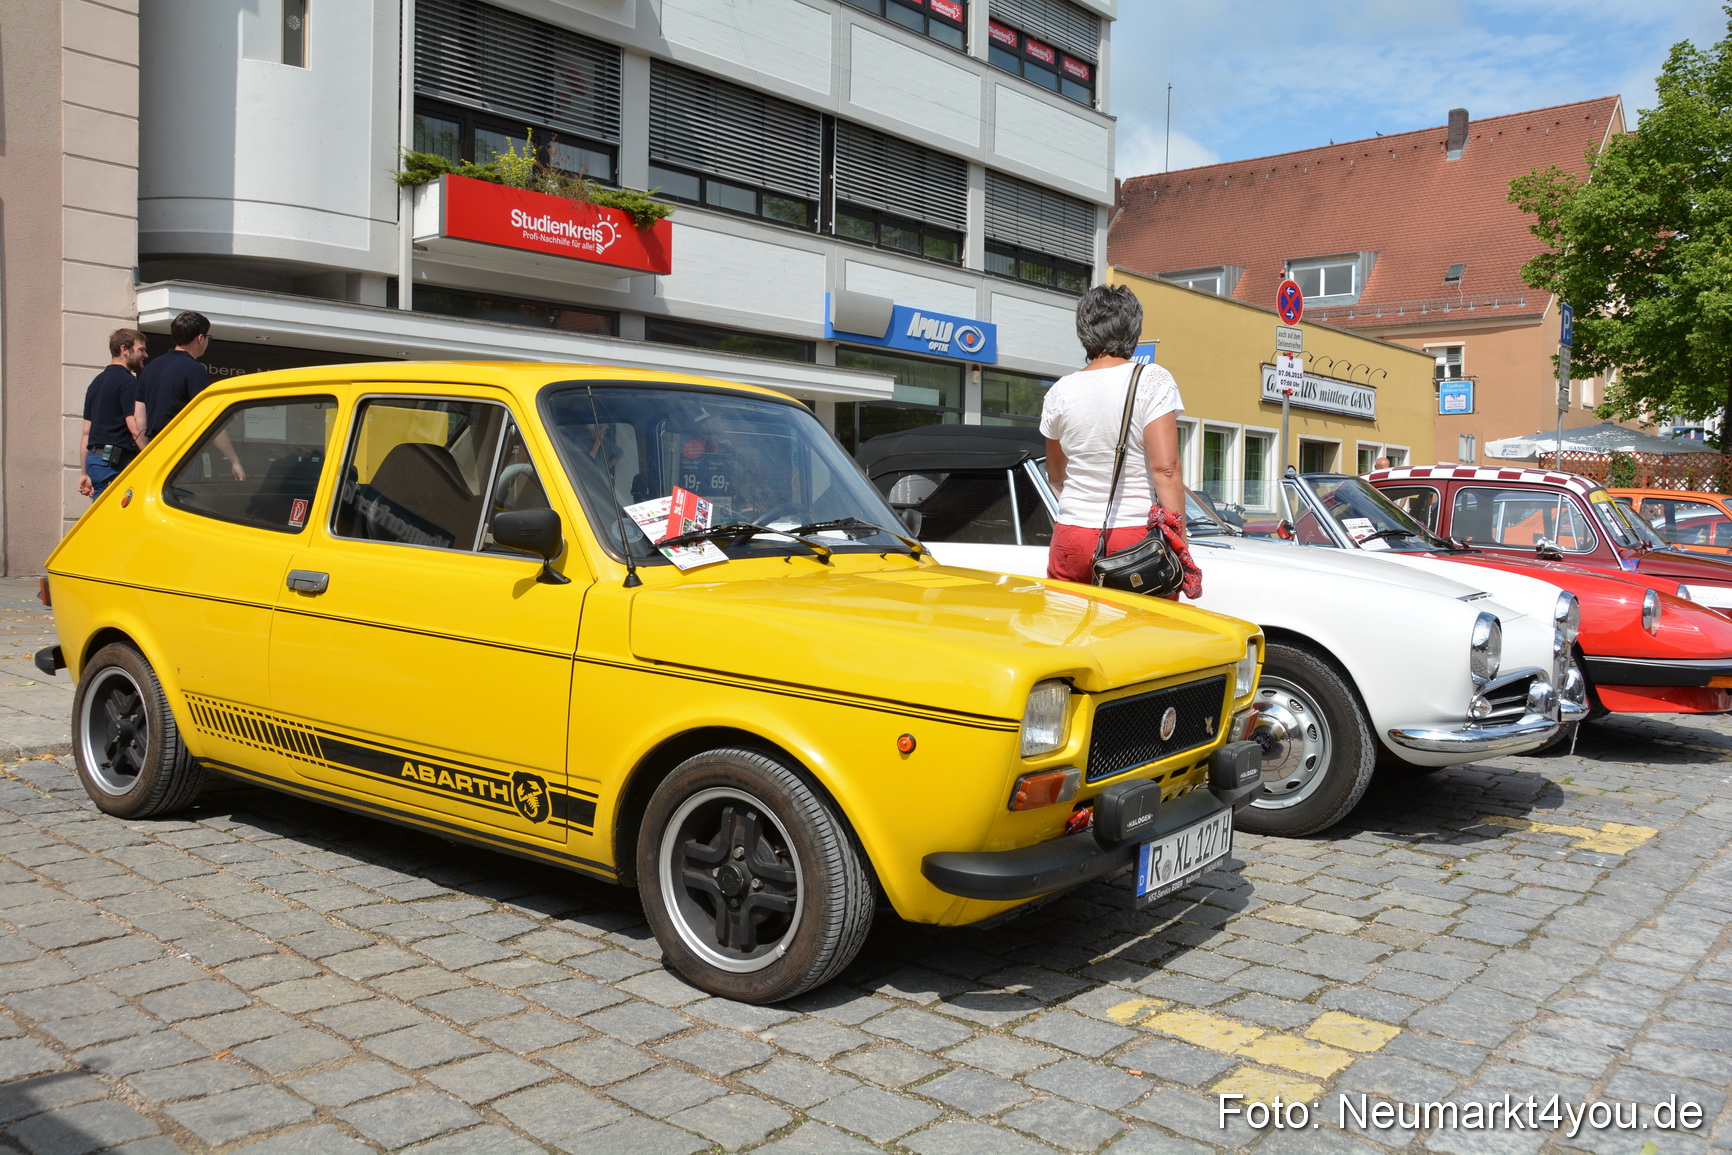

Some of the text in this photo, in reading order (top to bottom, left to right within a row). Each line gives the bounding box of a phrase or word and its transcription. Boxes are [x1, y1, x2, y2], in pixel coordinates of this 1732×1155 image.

[511, 208, 603, 243] Studienkreis
[522, 230, 595, 251] Profi-Nachhilfe für alle!
[906, 312, 954, 343] APOLLO
[1563, 309, 1571, 340] P
[1278, 330, 1287, 338] auch
[928, 341, 950, 353] OPTIK
[1277, 339, 1301, 350] Seitenstreifen
[1277, 369, 1303, 379] 07.06.2015
[1280, 379, 1292, 387] 07:00
[1319, 388, 1349, 406] mittlere
[1350, 391, 1372, 411] GANS
[400, 761, 510, 803] ABARTH
[1150, 813, 1230, 885] R XL 127 H
[1139, 874, 1145, 887] D
[1171, 881, 1183, 893] EDER
